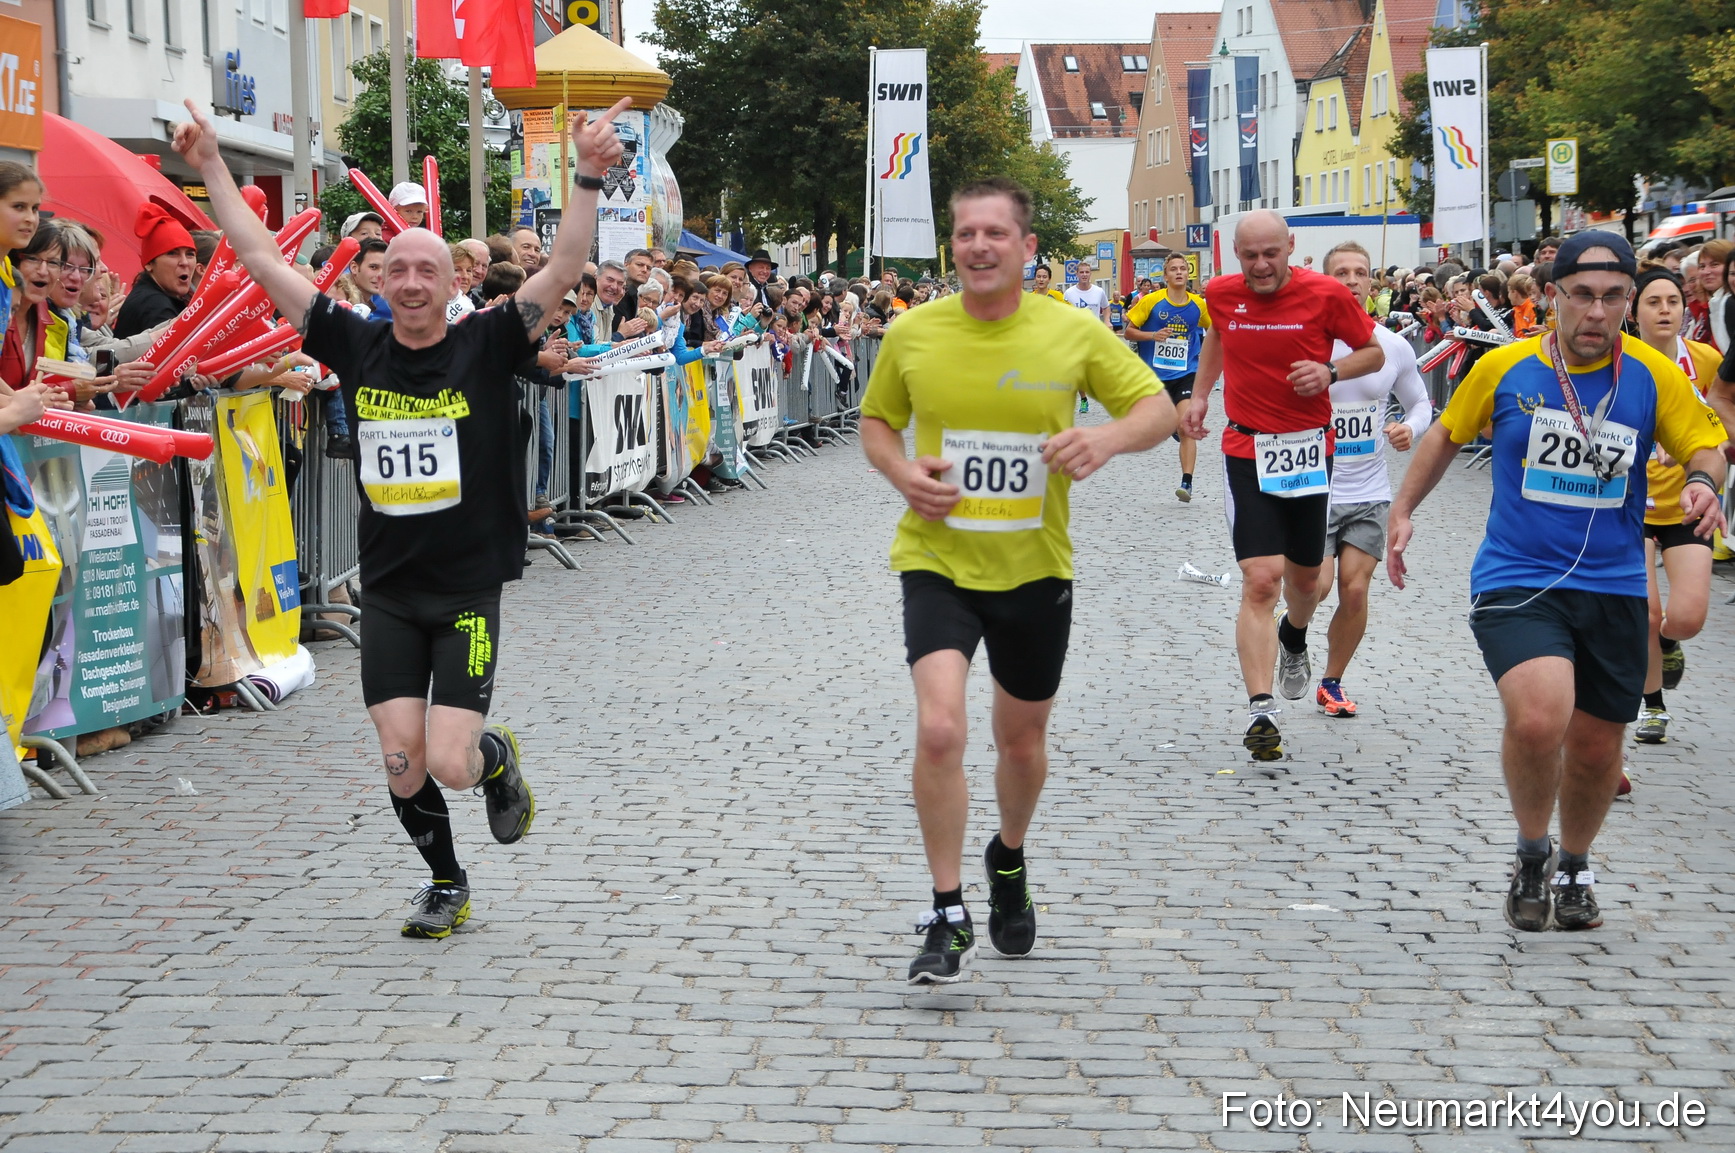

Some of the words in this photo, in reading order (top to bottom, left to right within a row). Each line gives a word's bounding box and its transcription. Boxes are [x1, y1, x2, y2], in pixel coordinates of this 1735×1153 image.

[1471, 330, 1490, 340] BMW
[1157, 344, 1185, 359] 2603
[1337, 407, 1368, 415] Neumarkt
[64, 421, 92, 437] BKK
[1334, 416, 1373, 440] 804
[1534, 416, 1570, 431] PARTL
[360, 430, 387, 440] PARTL
[389, 429, 438, 440] Neumarkt
[1256, 440, 1281, 448] PARTL
[1281, 437, 1314, 446] Neumarkt
[944, 437, 980, 450] PARTL
[981, 441, 1033, 453] Neumarkt
[377, 442, 438, 479] 615
[1264, 444, 1319, 475] 2349
[1537, 432, 1627, 475] 2847
[963, 456, 1029, 493] 603
[1280, 475, 1310, 489] Gerald
[1551, 476, 1604, 496] Thomas
[92, 626, 134, 643] Trockenbau
